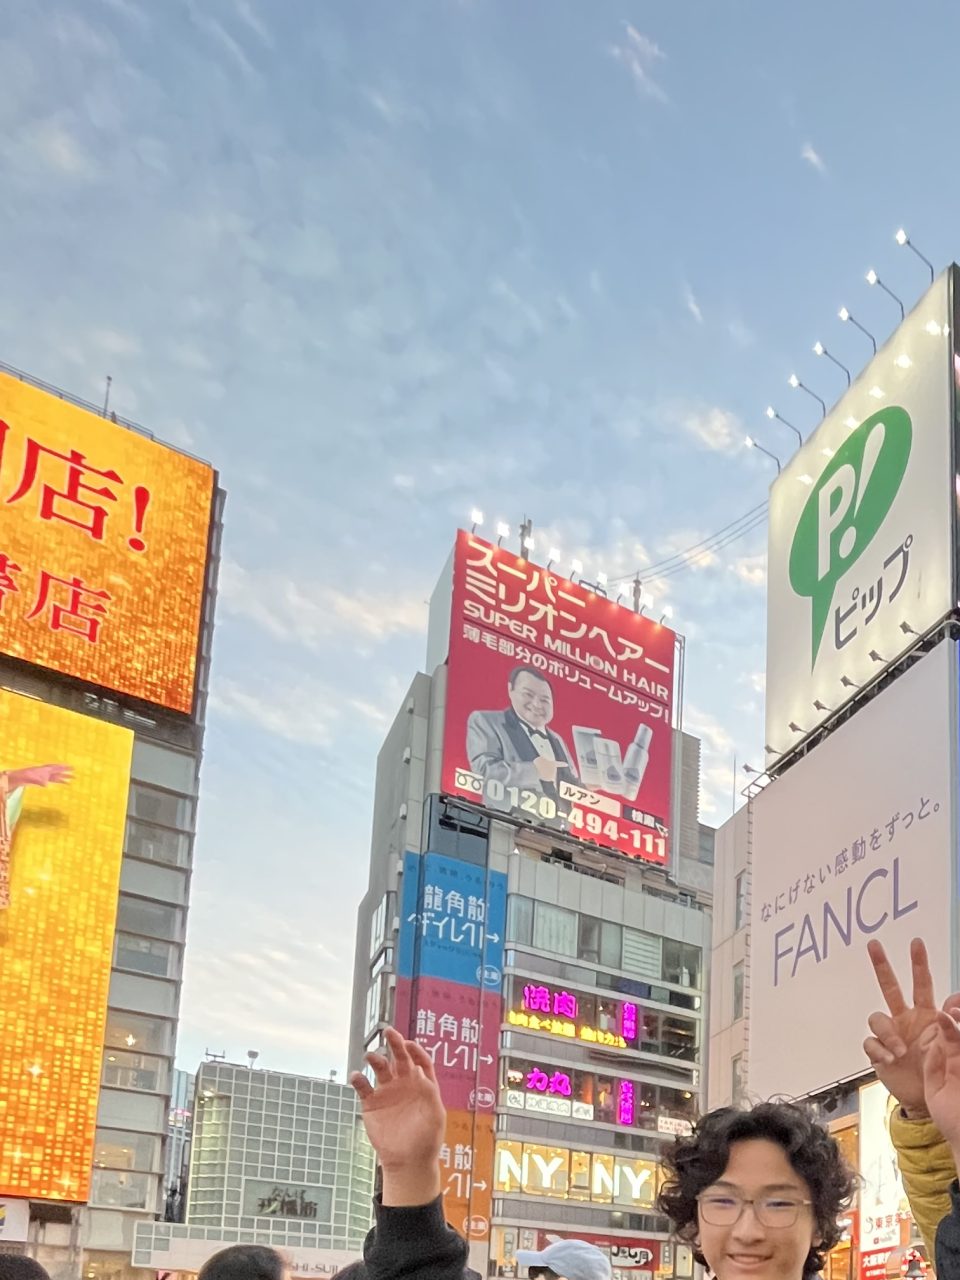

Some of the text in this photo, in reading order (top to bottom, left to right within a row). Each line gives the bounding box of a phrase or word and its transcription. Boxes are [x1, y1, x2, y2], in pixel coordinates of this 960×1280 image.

[0, 417, 151, 552] 店!
[466, 540, 586, 607] スーパー
[834, 534, 914, 650] ピップ
[463, 600, 670, 701] SUPER MILLION HAIR
[465, 568, 671, 674] ミリオンヘアー
[486, 780, 667, 857] 0120-494-111
[563, 785, 600, 806] ルアン
[761, 797, 941, 922] なにげない感動をずっと。
[423, 884, 489, 923] 龍角散
[774, 857, 918, 987] FANCL
[416, 1008, 483, 1045] 龍角散
[523, 985, 577, 1019] 焼肉
[526, 1067, 573, 1097] 力丸
[498, 1148, 564, 1188] NY
[593, 1162, 651, 1199] NY
